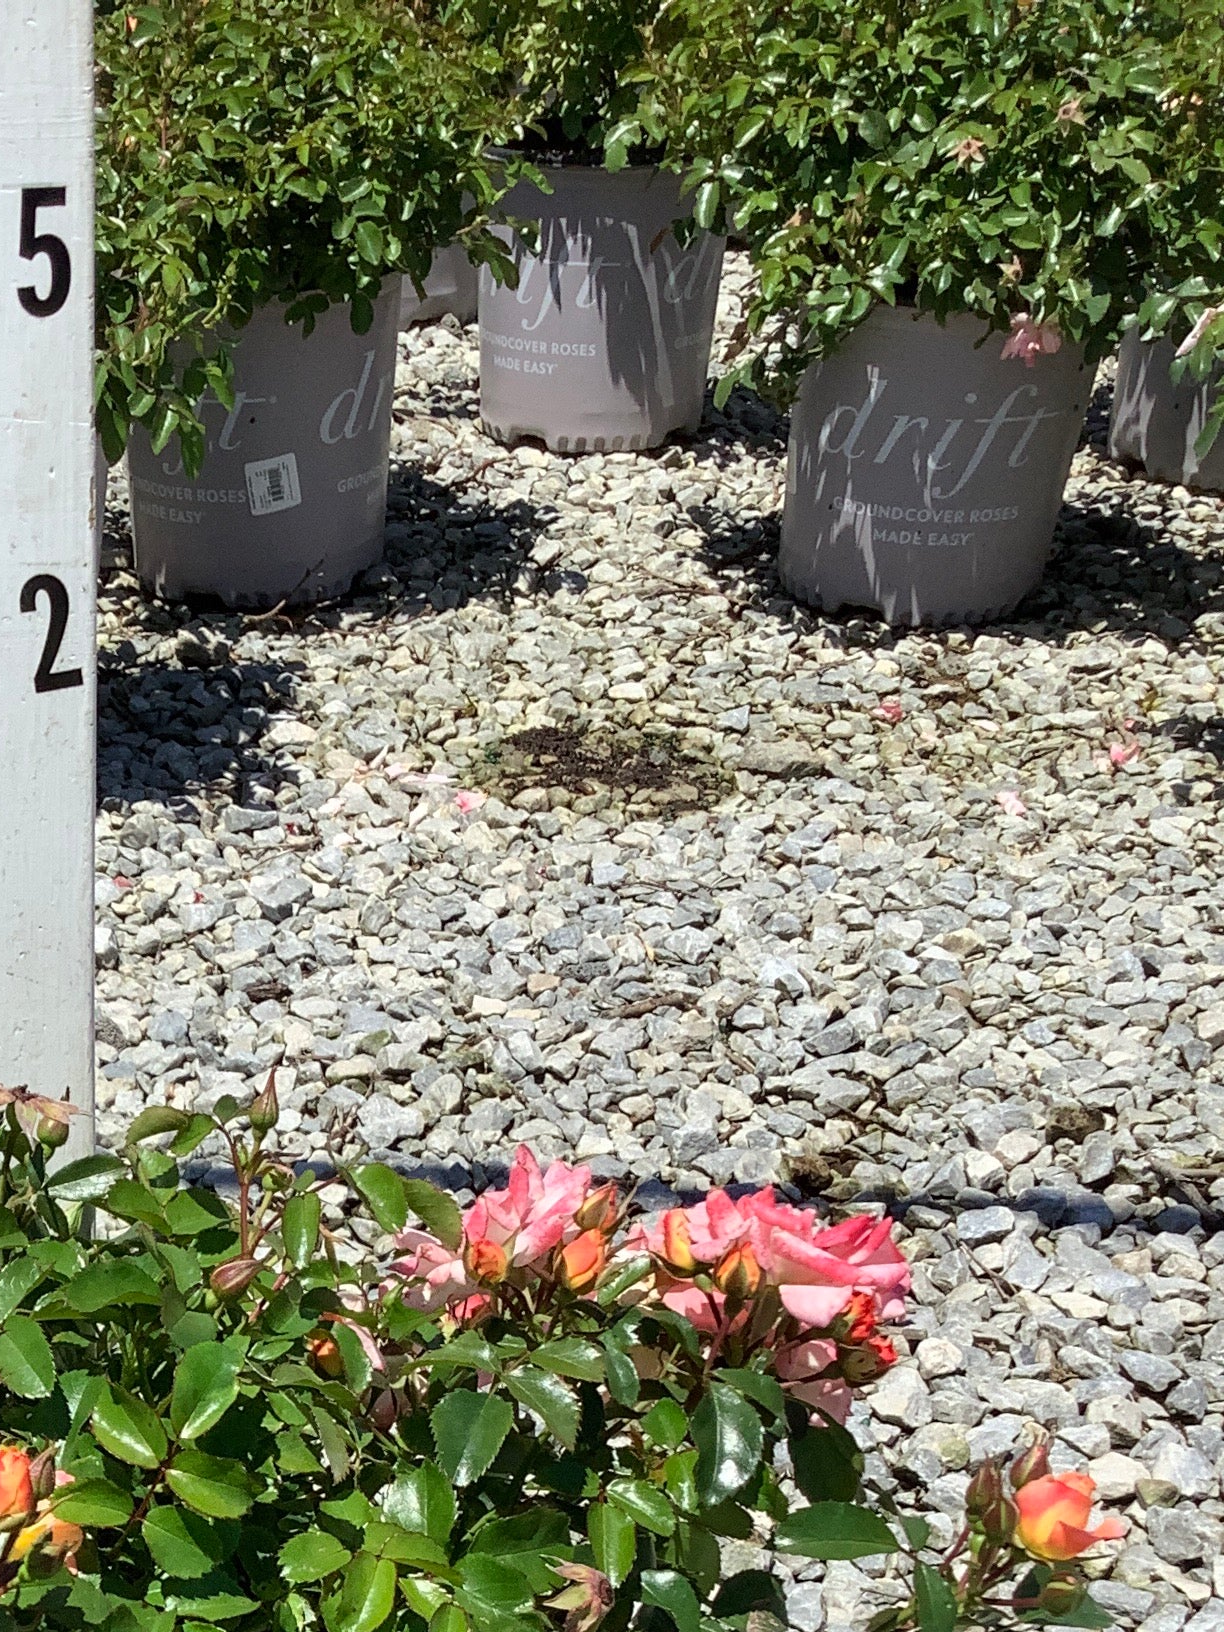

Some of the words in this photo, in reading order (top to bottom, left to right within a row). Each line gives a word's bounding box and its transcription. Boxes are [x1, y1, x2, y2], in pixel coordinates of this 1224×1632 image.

[551, 342, 596, 356] ROSES
[493, 355, 521, 371] MADE
[524, 360, 554, 374] EASY
[818, 379, 1061, 499] drift
[197, 489, 248, 503] ROSES
[169, 508, 202, 524] EASY
[833, 497, 964, 524] GROUNDCOVER
[970, 506, 1018, 523] ROSES
[873, 528, 922, 545] MADE
[928, 532, 970, 546] EASY
